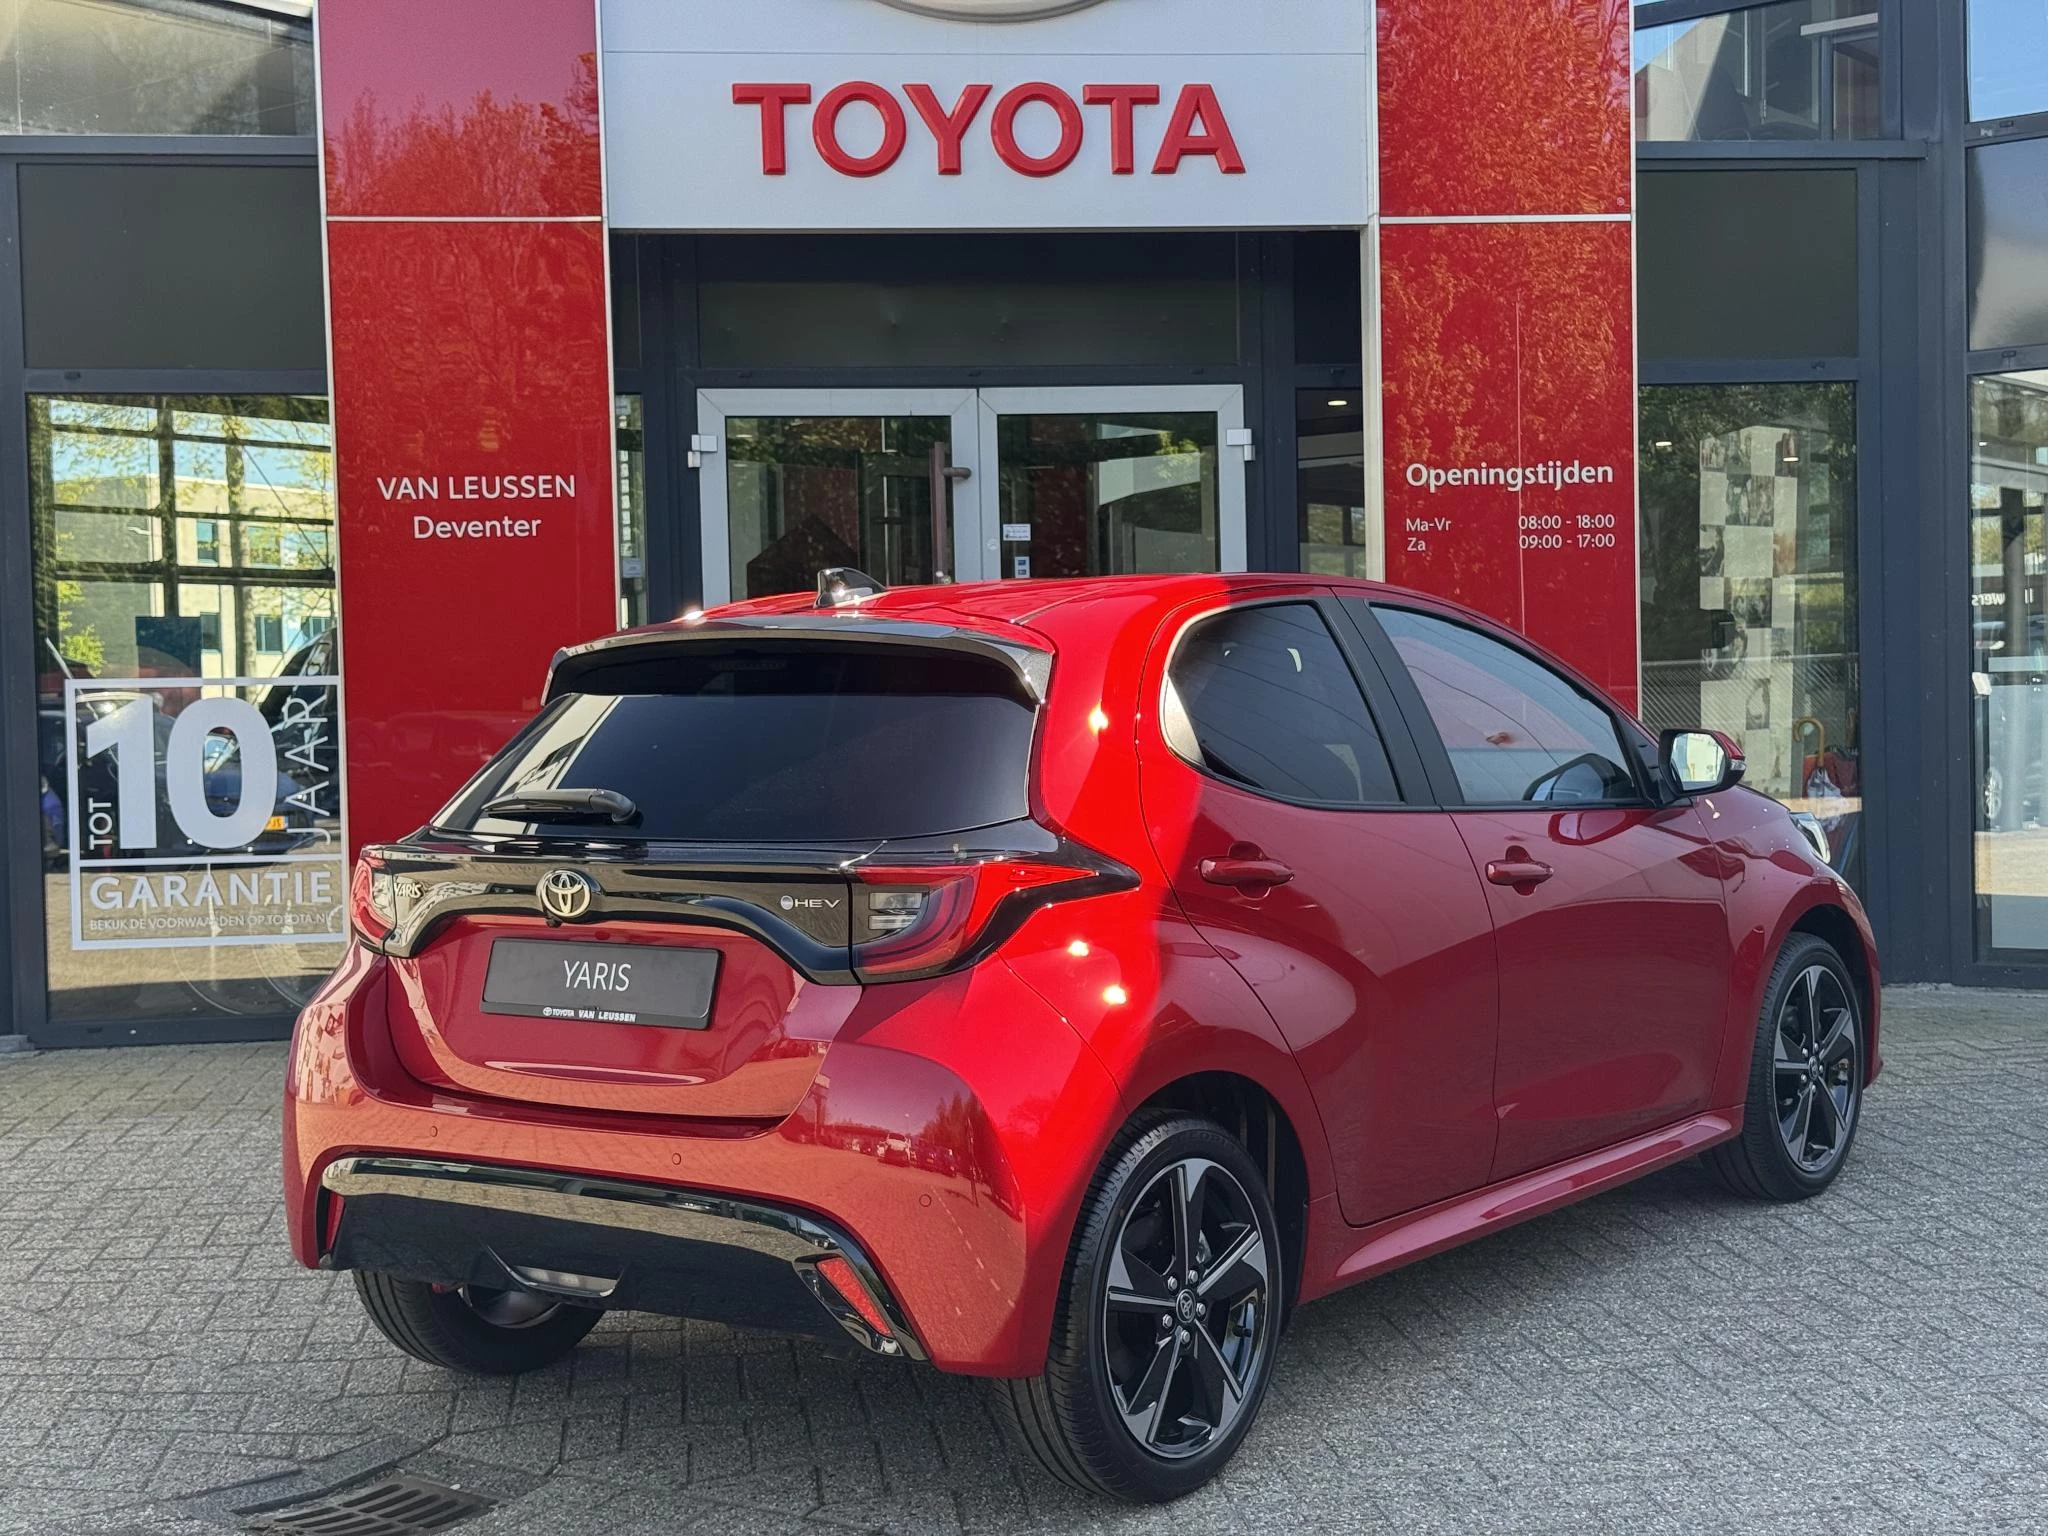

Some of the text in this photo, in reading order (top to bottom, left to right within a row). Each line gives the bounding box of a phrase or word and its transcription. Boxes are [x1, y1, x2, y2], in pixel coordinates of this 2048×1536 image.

[732, 81, 1246, 177] TOYOTA
[377, 475, 576, 500] VAN LEUSSEN
[1405, 460, 1614, 492] Openingstijden
[413, 516, 542, 539] Deventer
[1405, 517, 1452, 532] Ma-Vr
[1518, 515, 1562, 530] 08:00
[1576, 514, 1616, 529] 18:00
[1407, 537, 1427, 552] Za
[1519, 535, 1563, 550] 09:00
[1576, 533, 1616, 549] 17:00
[86, 697, 278, 849] 10
[284, 694, 332, 845] JAAR
[89, 797, 113, 850] TOT
[89, 871, 332, 910] GARANTIE
[394, 882, 422, 899] YARIS
[795, 898, 841, 909] HEV
[130, 918, 146, 930] DE
[247, 915, 264, 926] OP
[563, 959, 632, 992] YARIS
[552, 1008, 636, 1023] TOYOTA VAN LEUSSEN
